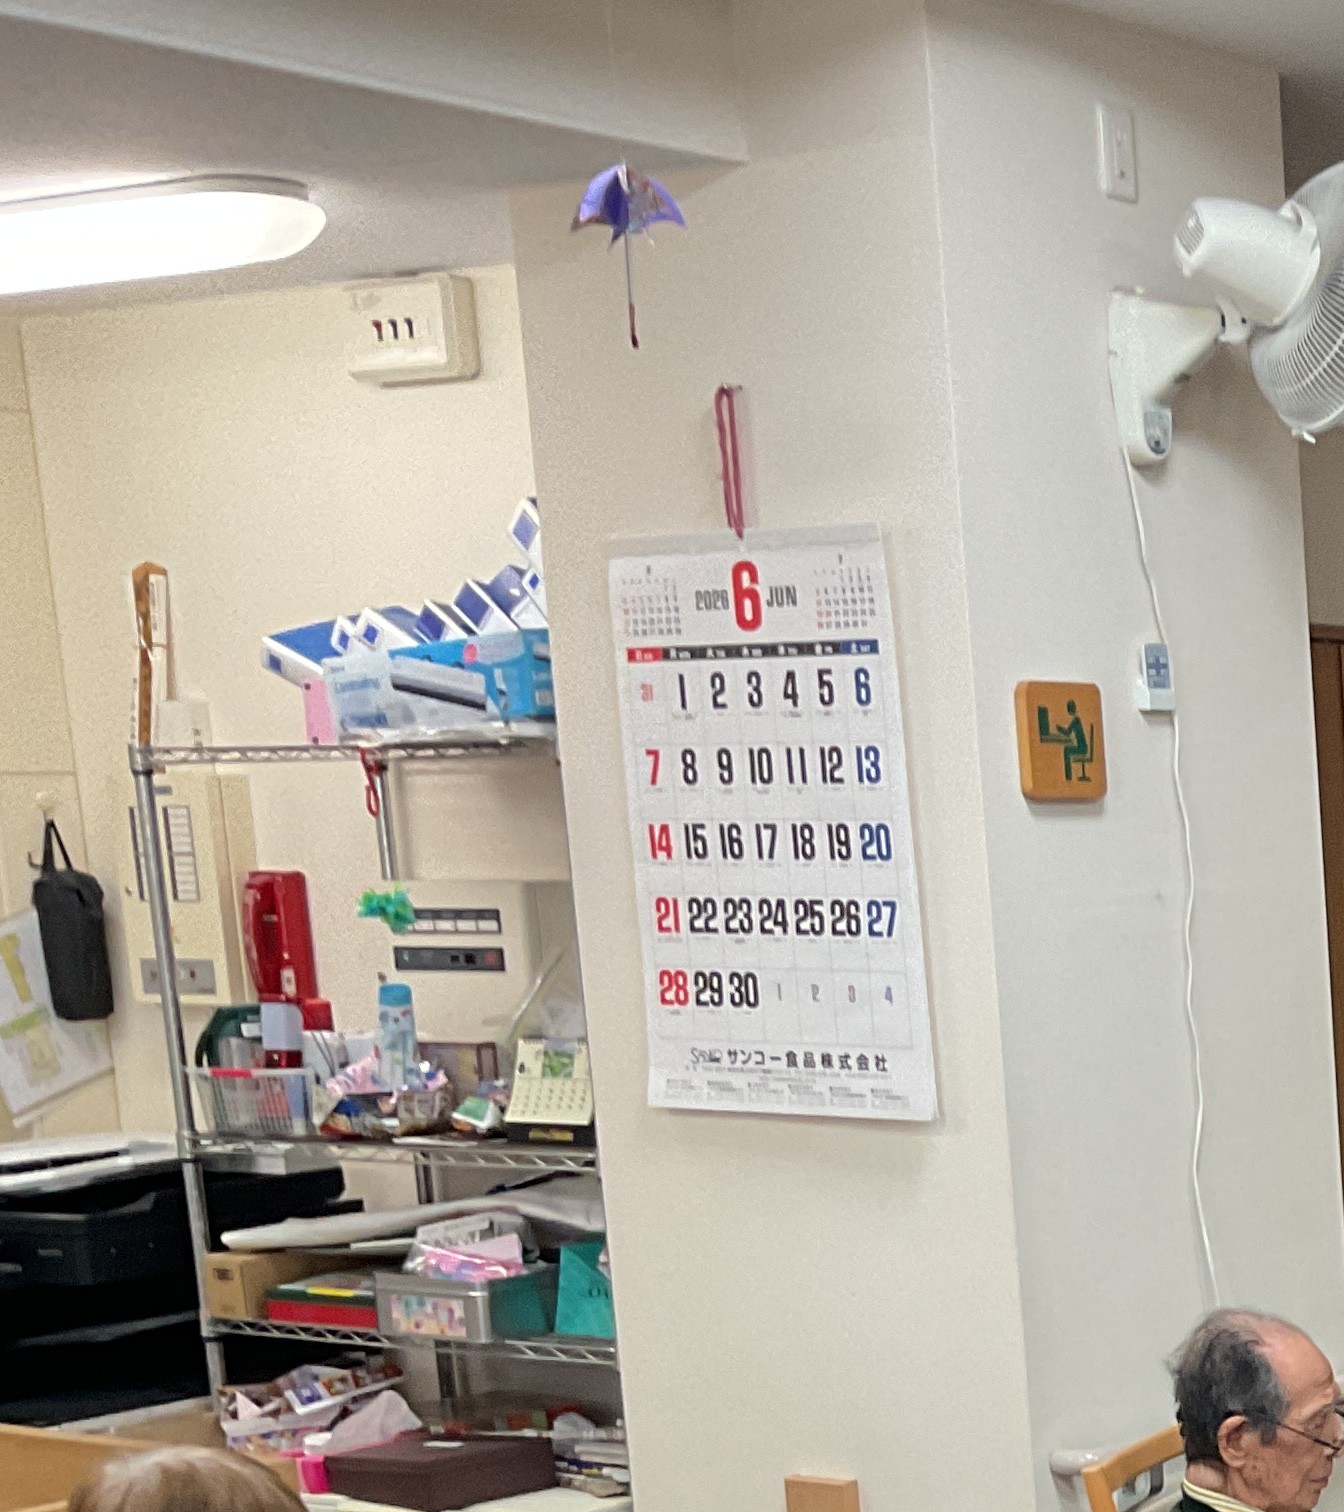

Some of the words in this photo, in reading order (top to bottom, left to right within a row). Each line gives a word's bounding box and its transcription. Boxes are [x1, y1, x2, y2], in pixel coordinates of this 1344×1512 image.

[731, 560, 763, 632] 6
[766, 585, 798, 608] JUN
[677, 673, 688, 711] 1
[710, 671, 728, 710] 2
[746, 670, 763, 709] 3
[782, 669, 799, 708] 4
[816, 668, 835, 707] 5
[853, 666, 872, 707] 6
[645, 748, 660, 786] 7
[680, 748, 699, 786] 8
[716, 747, 734, 786] 9
[748, 746, 774, 785] 10
[785, 746, 808, 785] 11
[819, 745, 845, 785] 12
[855, 745, 882, 785] 13
[648, 823, 673, 861] 14
[683, 823, 709, 860] 15
[718, 822, 744, 860] 16
[754, 822, 778, 861] 17
[791, 822, 816, 861] 18
[826, 822, 852, 861] 19
[858, 822, 893, 862] 20
[655, 896, 681, 934] 21
[687, 896, 719, 934] 22
[723, 897, 754, 935] 23
[757, 897, 789, 936] 24
[793, 898, 825, 937] 25
[829, 898, 862, 938] 26
[866, 899, 897, 938] 27
[658, 969, 690, 1007] 28
[693, 970, 724, 1008] 29
[728, 971, 760, 1009] 30
[727, 1048, 889, 1072] サンコー食品株式会社
